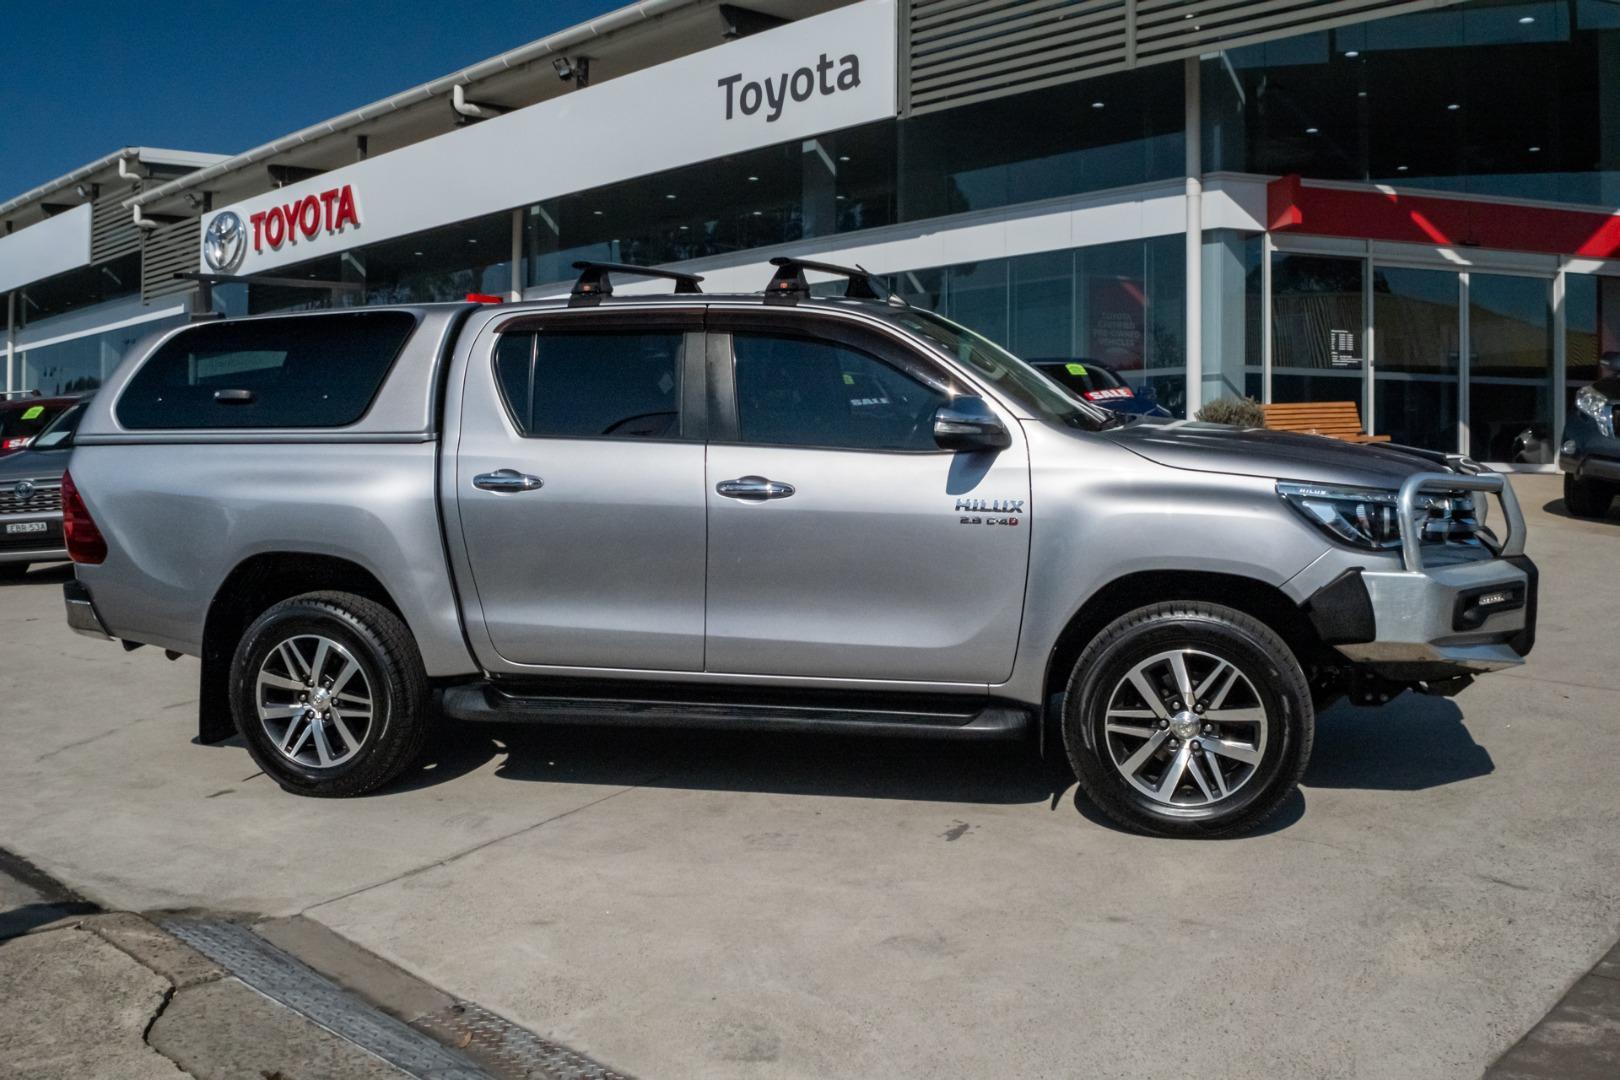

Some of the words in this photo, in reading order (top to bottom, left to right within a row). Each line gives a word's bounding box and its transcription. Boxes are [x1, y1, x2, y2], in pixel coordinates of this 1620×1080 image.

[717, 53, 861, 122] Toyota
[250, 184, 359, 252] TOYOTA
[1089, 388, 1129, 399] SALE
[955, 499, 1024, 513] HILUX
